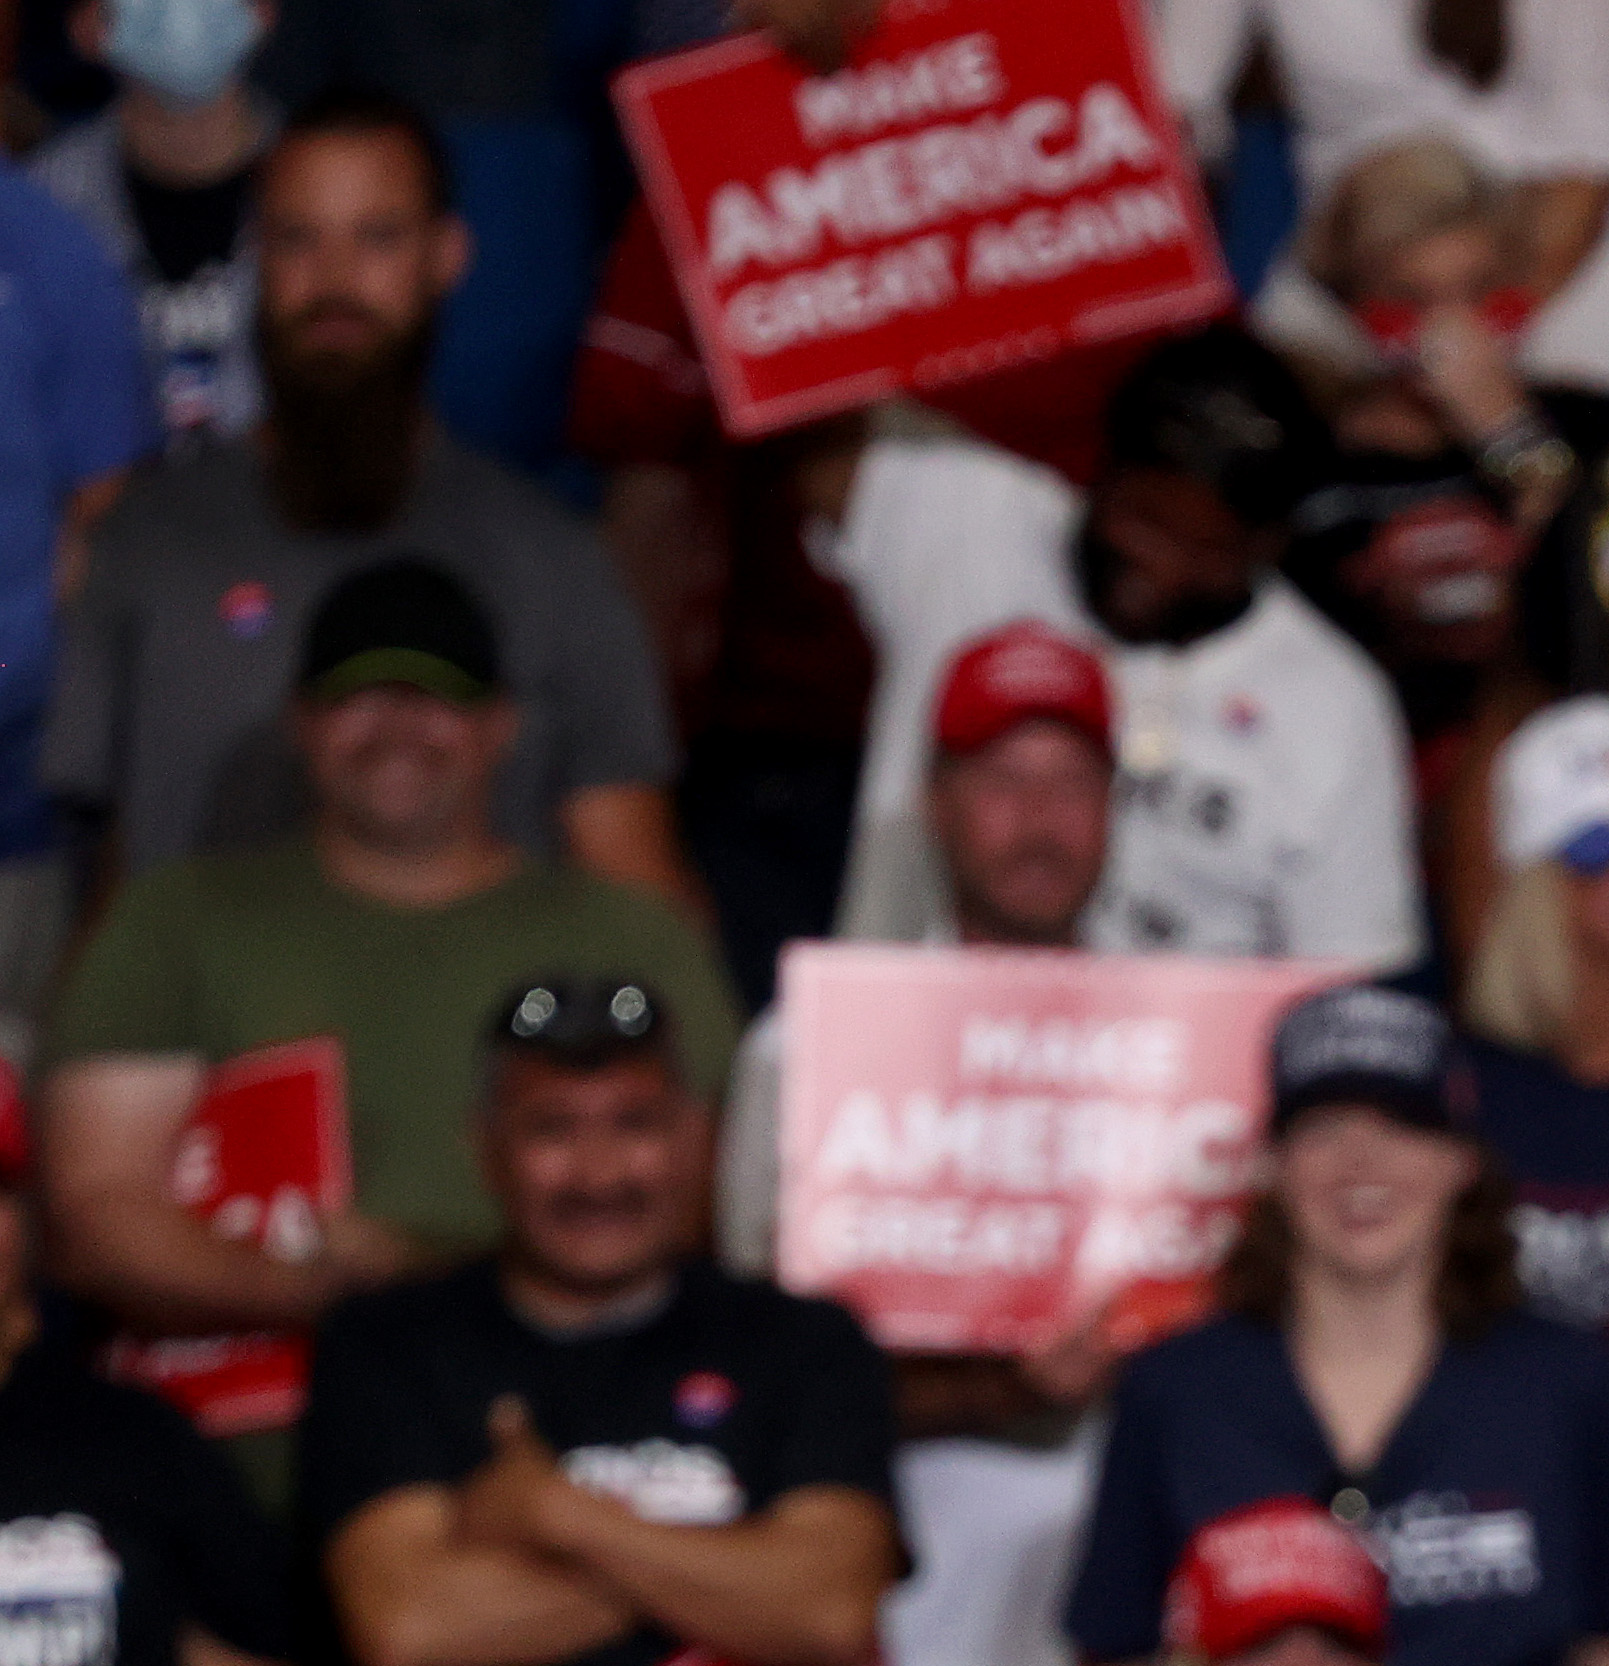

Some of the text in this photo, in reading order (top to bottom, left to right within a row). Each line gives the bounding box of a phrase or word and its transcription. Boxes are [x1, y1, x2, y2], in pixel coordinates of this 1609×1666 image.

[796, 32, 1000, 141] MAKE
[707, 80, 1157, 275] AMERICA
[724, 183, 1187, 358] GREAT AGAIN
[958, 1015, 1191, 1086] MAKE
[818, 1090, 1268, 1198] AMERIC
[807, 1200, 1250, 1281] GREAT AGA
